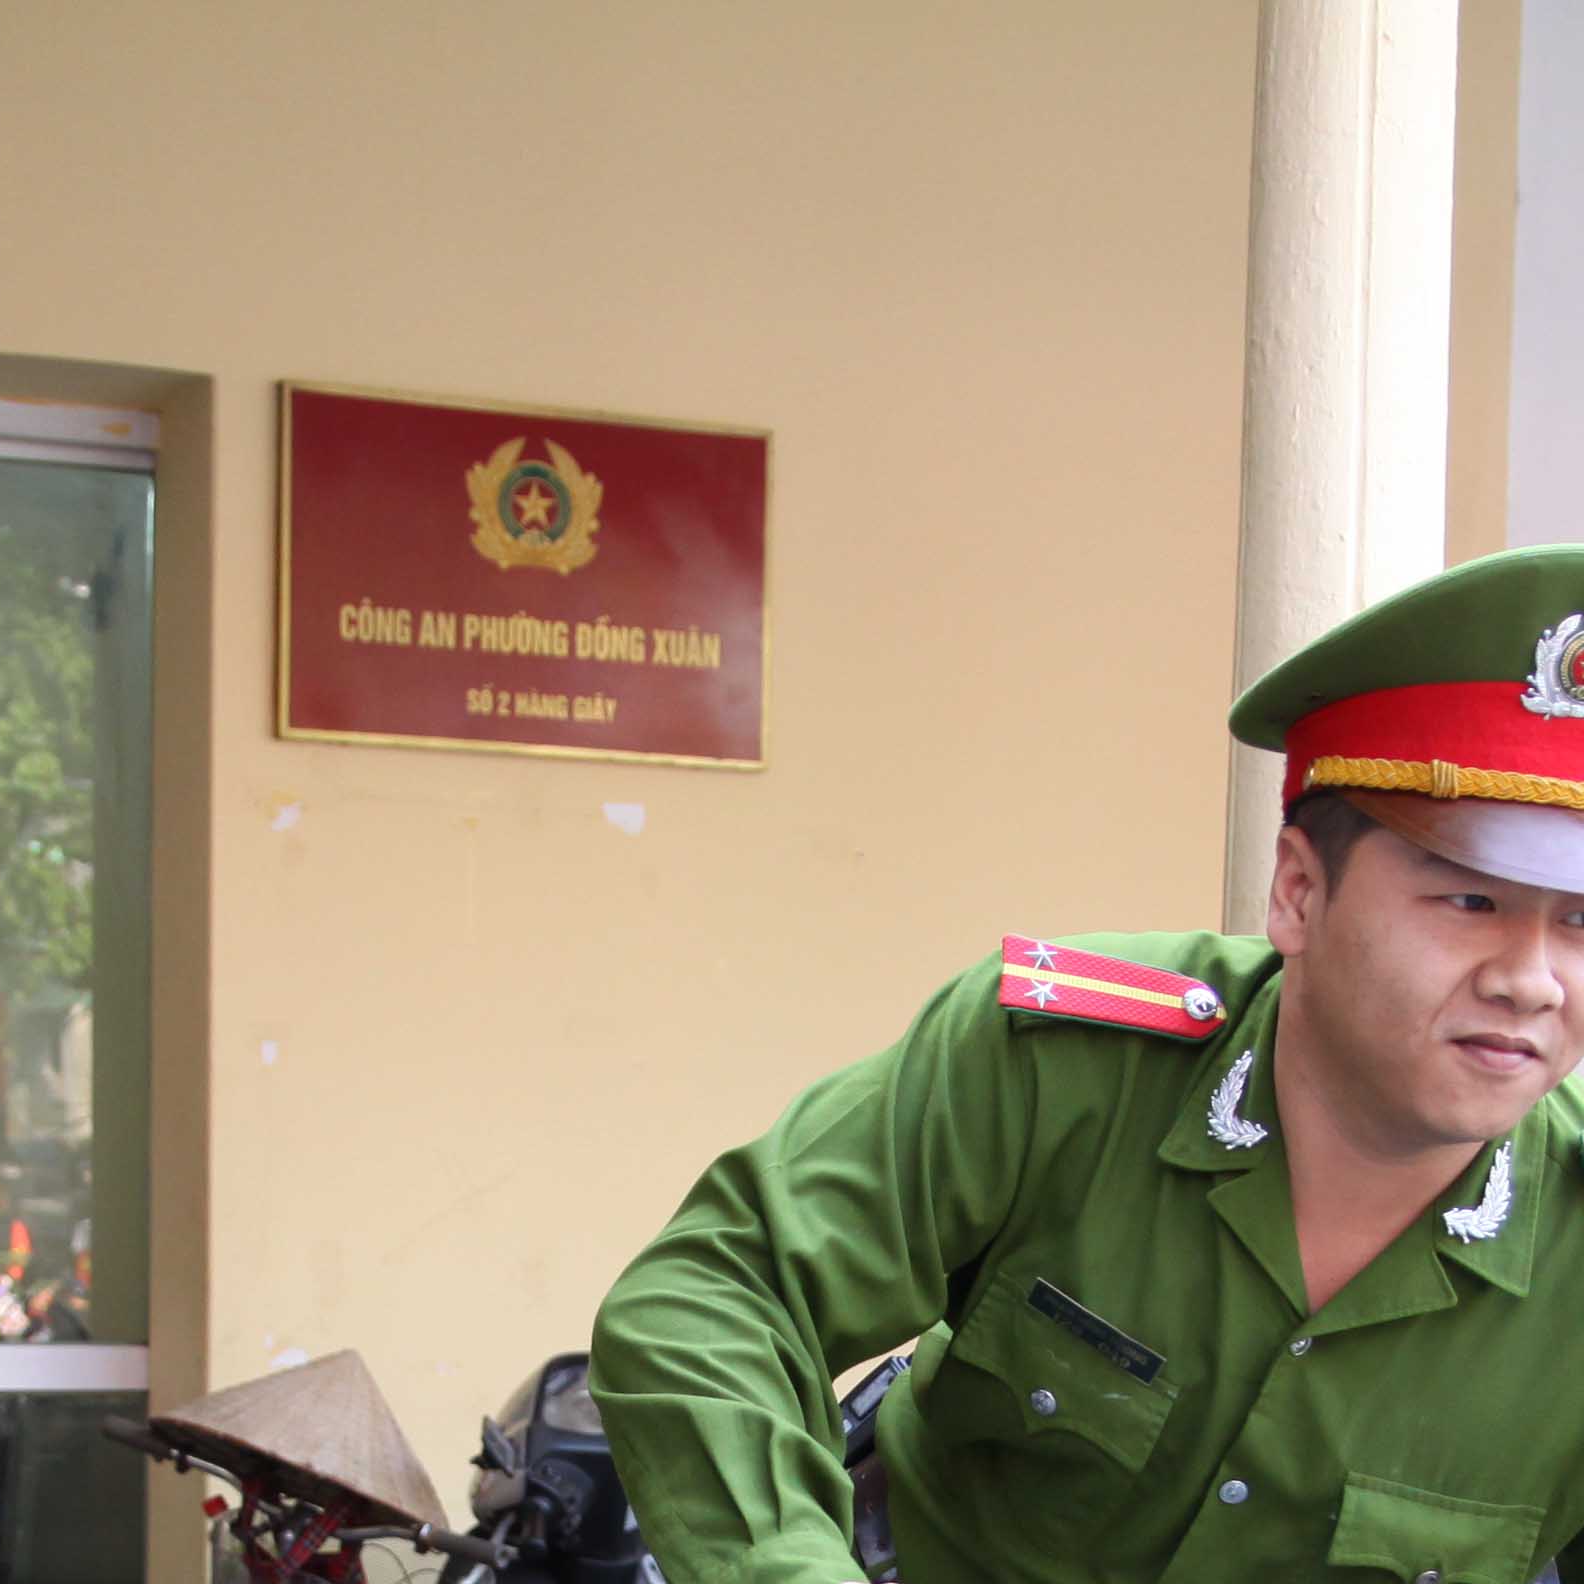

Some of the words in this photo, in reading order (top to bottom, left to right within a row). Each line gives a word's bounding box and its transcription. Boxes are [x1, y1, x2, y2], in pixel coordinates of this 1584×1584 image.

[339, 597, 412, 645] CÔNG
[419, 611, 457, 649] AN
[652, 623, 721, 669] XUÂN
[496, 690, 512, 717] 2
